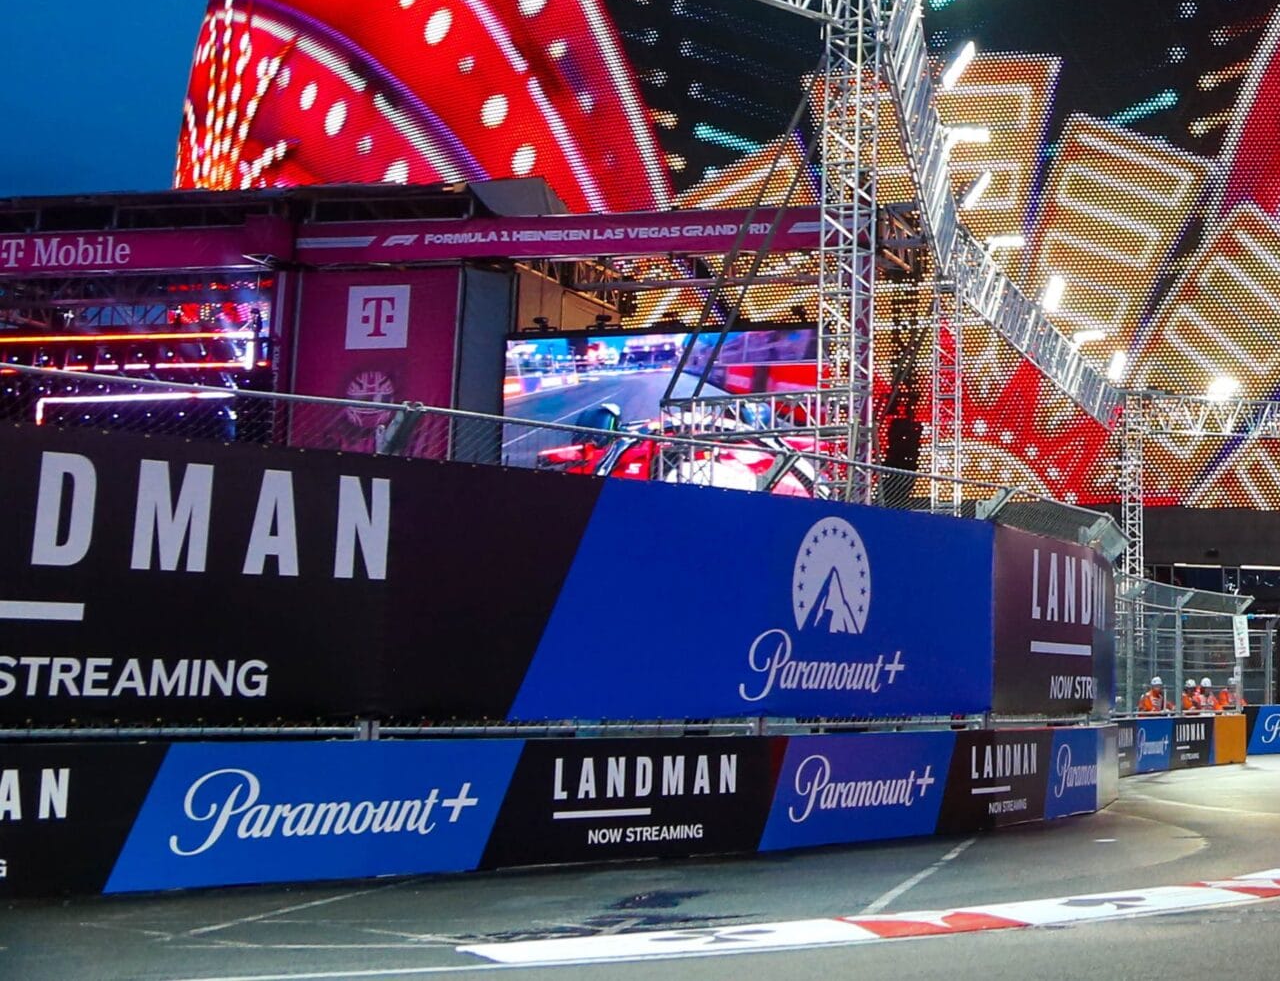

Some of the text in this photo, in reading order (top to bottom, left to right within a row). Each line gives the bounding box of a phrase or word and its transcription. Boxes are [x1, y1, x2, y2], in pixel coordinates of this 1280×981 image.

[31, 236, 131, 267] Mobile
[425, 231, 498, 245] FORMULA
[500, 230, 510, 242] 1
[512, 229, 590, 241] HEINEKEN
[593, 228, 625, 240] LAS
[627, 226, 681, 239] VEGAS
[682, 224, 738, 237] GRAND
[739, 223, 776, 235] RI
[0, 656, 268, 697] STREAMING
[739, 628, 905, 701] Paramount+
[1050, 675, 1073, 699] NOW
[553, 754, 737, 800] LANDMAN
[971, 743, 1037, 779] LANDMAN
[788, 754, 935, 823] Paramount+
[169, 768, 479, 856] Paramount+
[588, 824, 703, 844] NOW STREAMING
